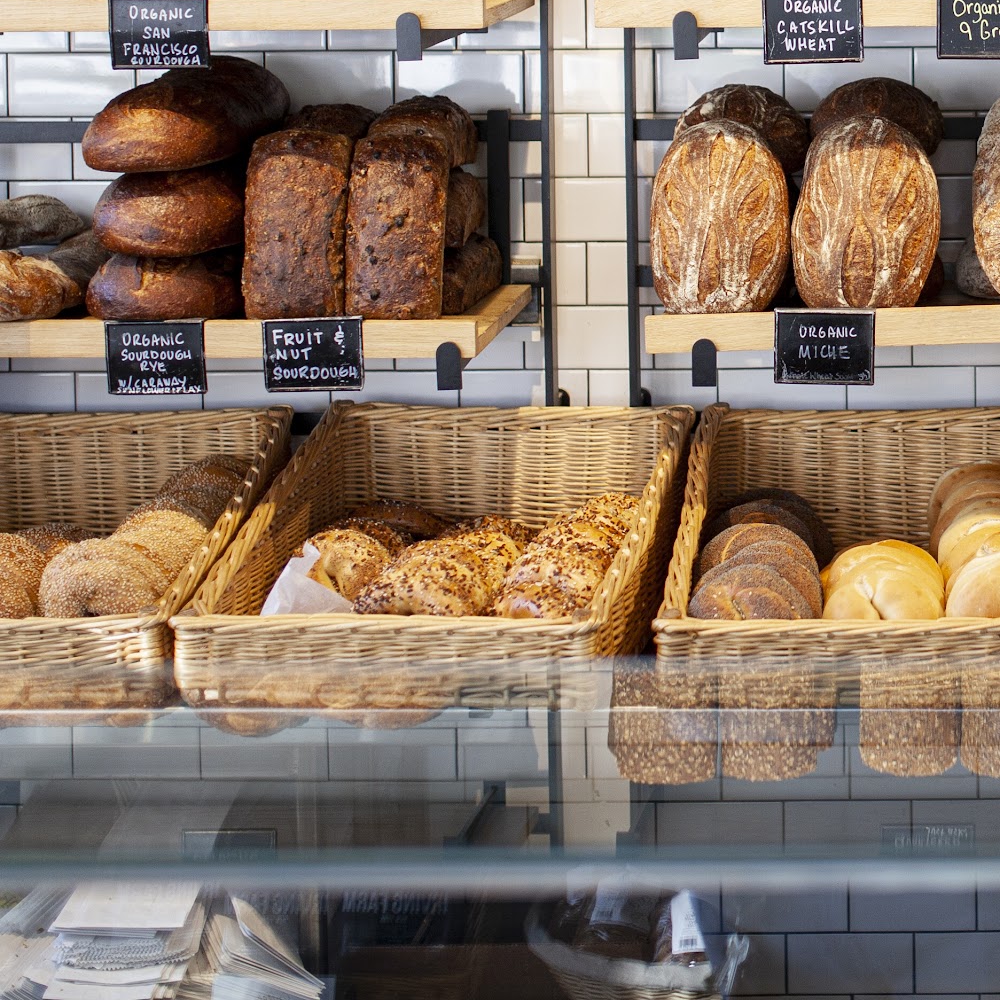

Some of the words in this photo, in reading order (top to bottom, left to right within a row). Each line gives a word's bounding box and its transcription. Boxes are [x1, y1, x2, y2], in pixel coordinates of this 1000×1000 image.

[129, 5, 194, 21] ORGANIC
[142, 26, 171, 40] SAN
[777, 19, 855, 35] CATSKILL
[959, 21, 972, 40] 9
[122, 42, 198, 56] FRANCISCO
[783, 37, 837, 51] WHEAT
[130, 54, 201, 66] SOURDOUGH
[799, 324, 858, 339] ORGANIC
[122, 332, 185, 347] ORGANIC
[121, 348, 192, 362] SOURDOUGH
[275, 347, 313, 361] NUT
[798, 344, 851, 360] MICHE
[140, 360, 167, 372] RYE
[272, 365, 358, 380] SOURDOUGH
